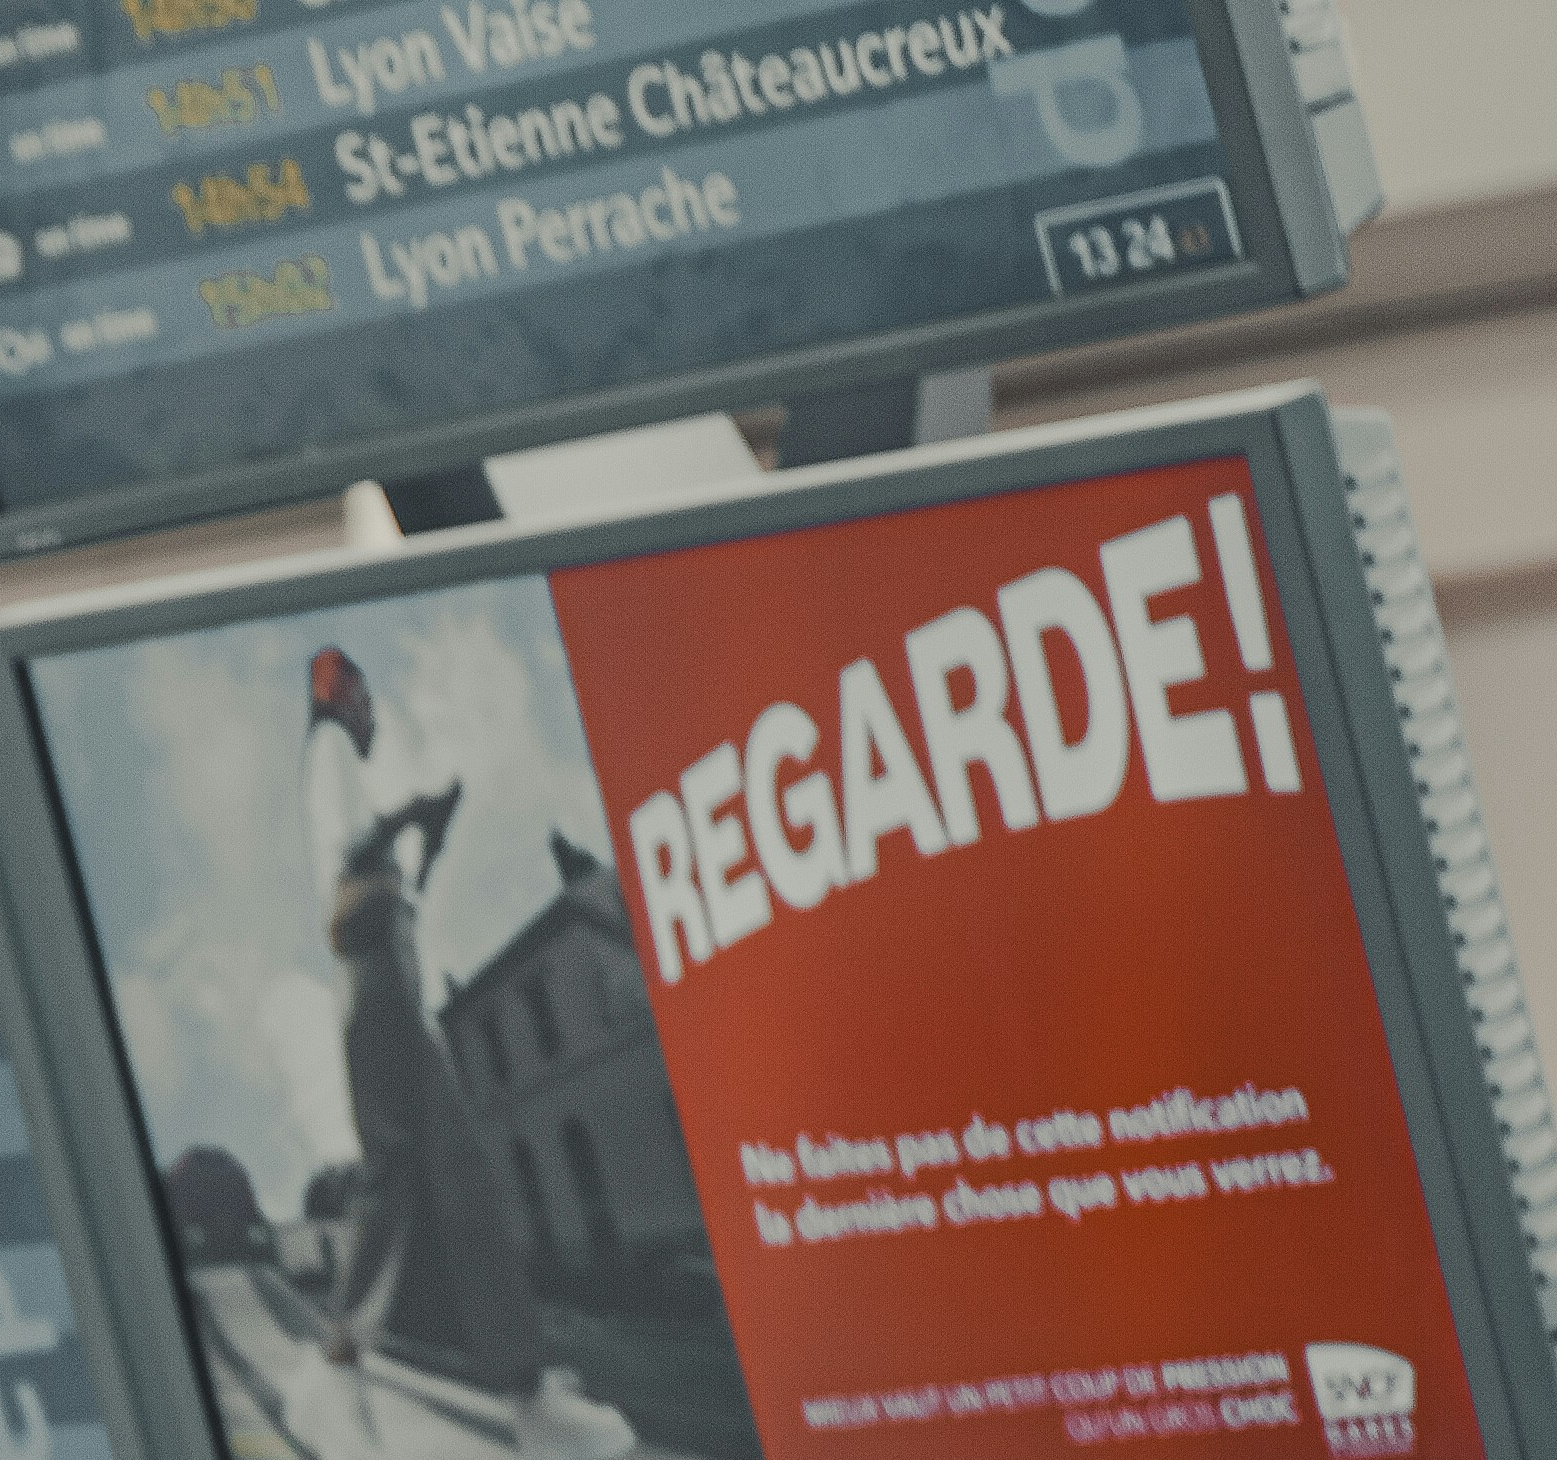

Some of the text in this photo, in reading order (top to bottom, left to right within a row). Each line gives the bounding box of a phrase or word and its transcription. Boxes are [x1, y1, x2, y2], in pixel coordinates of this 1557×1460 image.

[308, 30, 446, 120] Lyon
[442, 0, 598, 74] Vaise
[335, 92, 625, 204] St-Etienne
[627, 8, 1016, 138] Châteaucreux
[360, 227, 496, 312] Lyon
[494, 166, 741, 270] Perrache
[628, 492, 1303, 985] REGARDE!
[961, 1112, 1012, 1164] de
[1108, 1082, 1311, 1143] notification
[1048, 1174, 1117, 1223] que
[1122, 1159, 1207, 1203] vous
